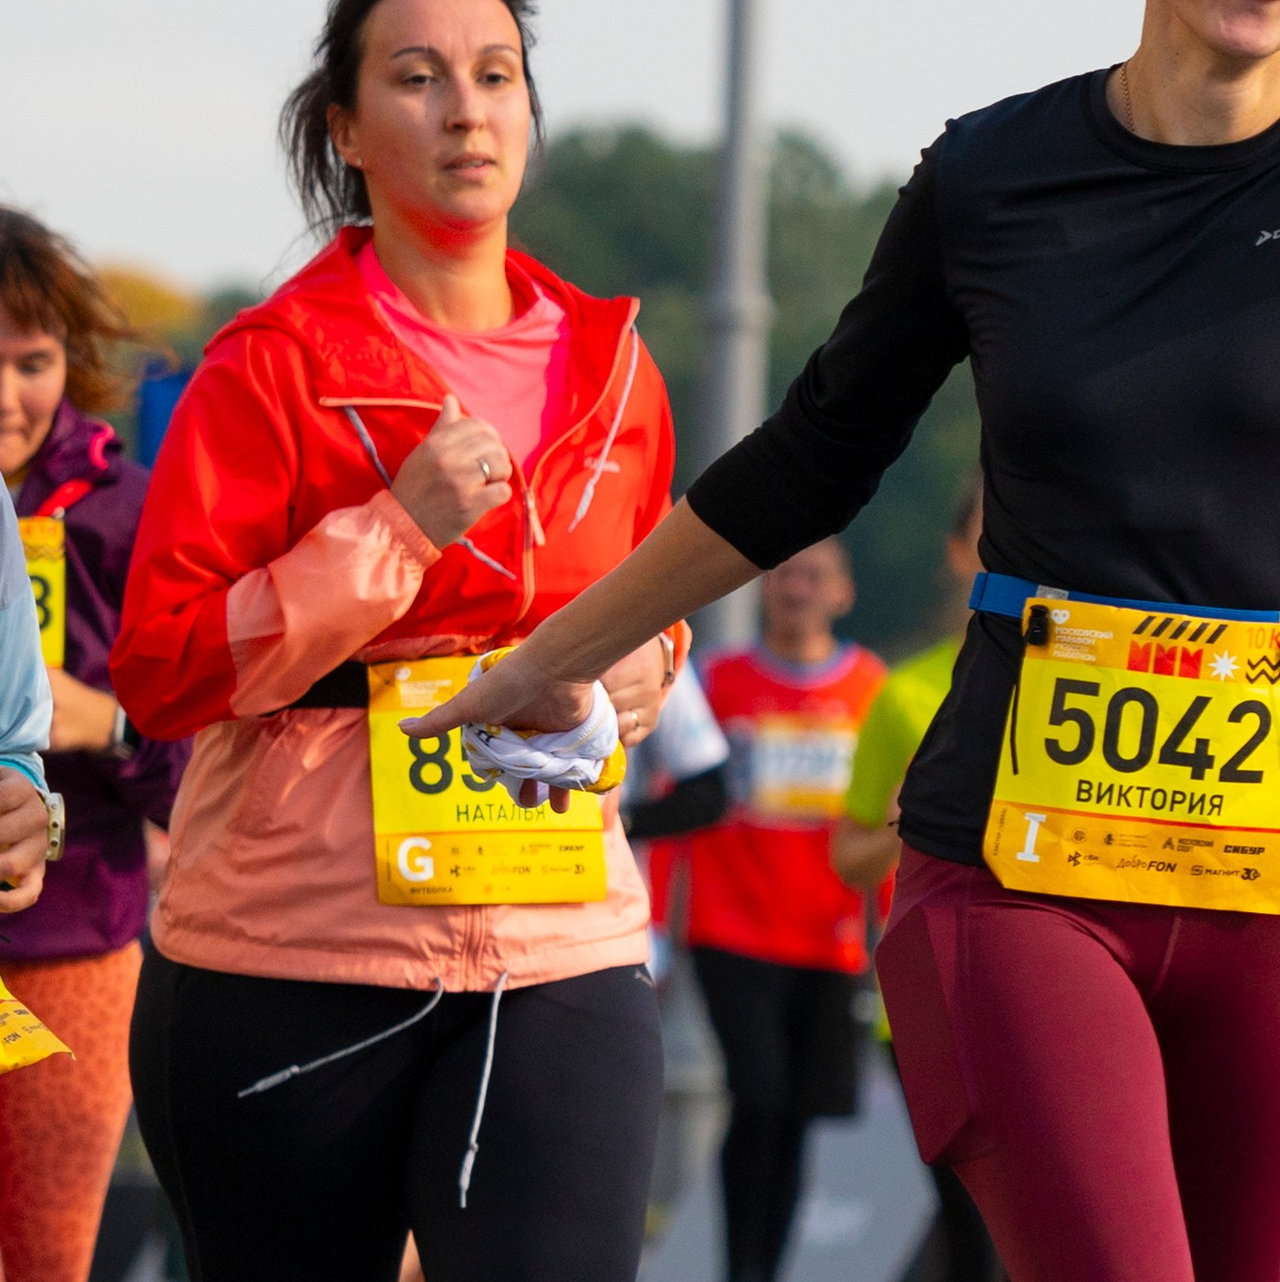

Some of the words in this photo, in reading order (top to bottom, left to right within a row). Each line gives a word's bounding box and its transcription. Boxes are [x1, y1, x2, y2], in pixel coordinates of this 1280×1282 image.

[1246, 627, 1265, 649] 10
[1044, 677, 1272, 784] 5042
[1076, 779, 1224, 816] ВИКТОРИЯ
[397, 836, 435, 883] G
[1223, 844, 1266, 855] СИБУР
